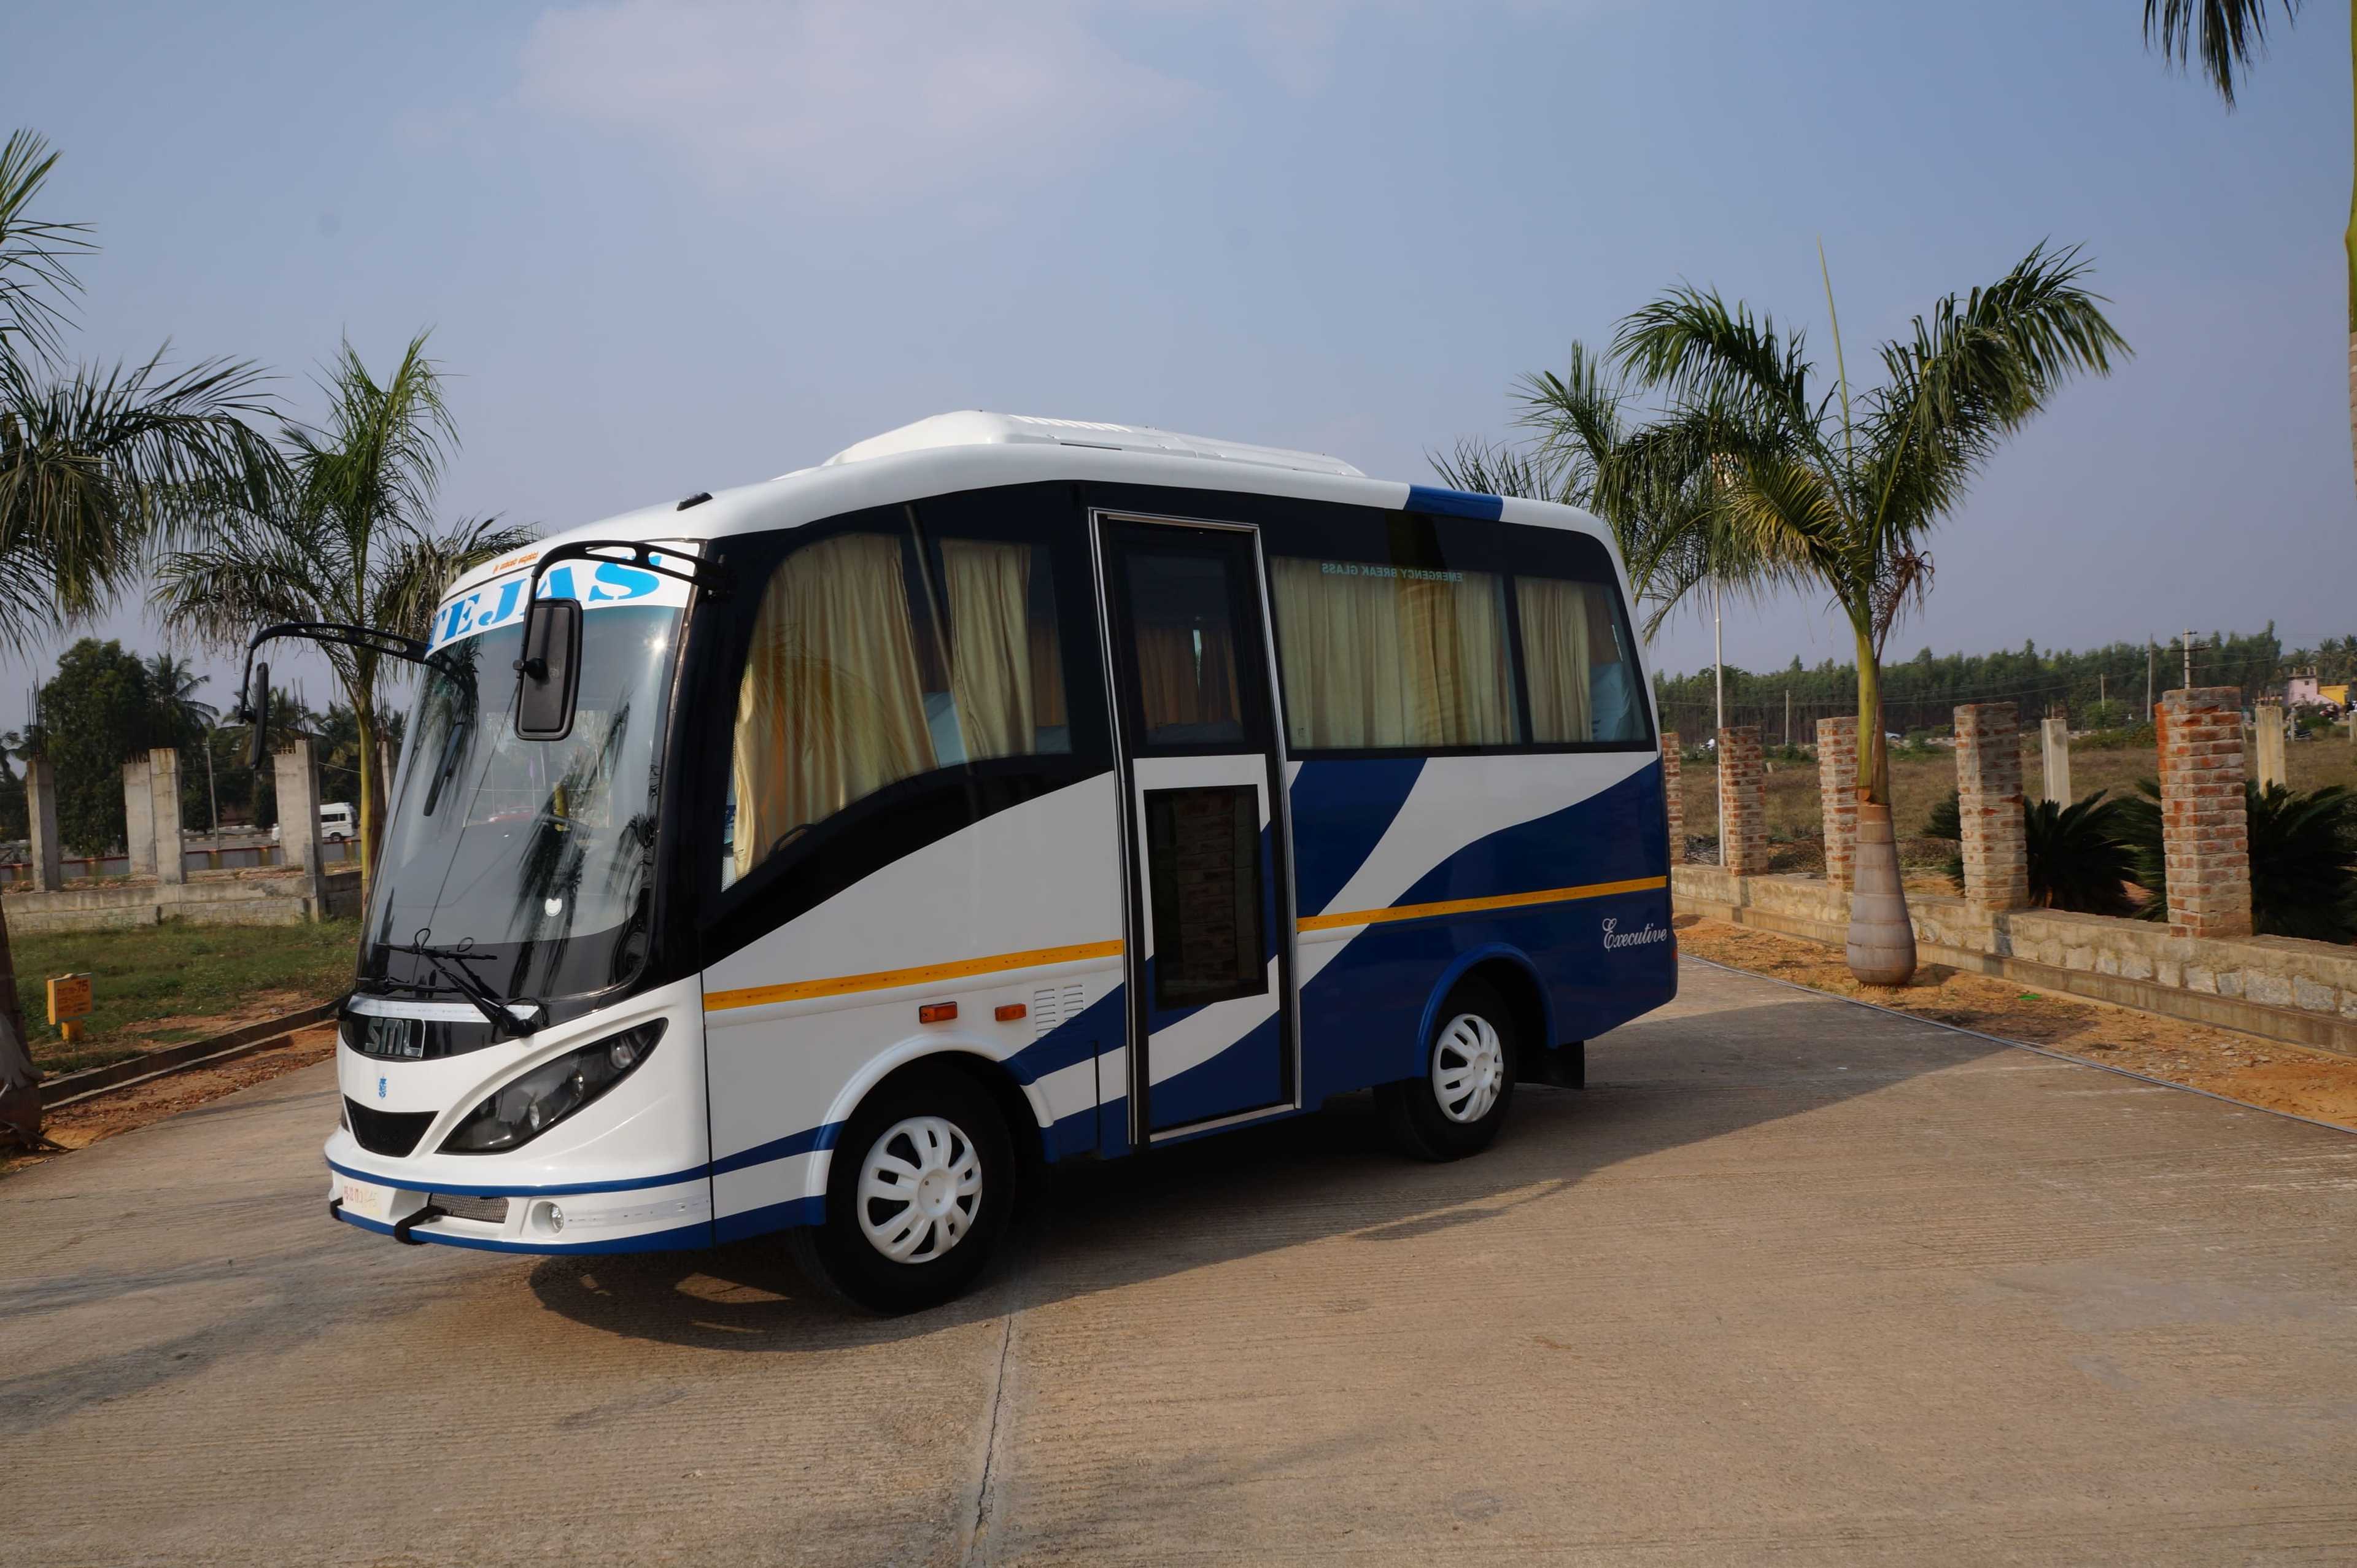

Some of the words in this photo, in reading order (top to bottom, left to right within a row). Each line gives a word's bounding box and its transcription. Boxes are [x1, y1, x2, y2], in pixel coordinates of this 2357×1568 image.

[425, 554, 662, 652] TEJAS
[1602, 918, 1668, 952] Executive
[365, 1018, 422, 1057] SML
